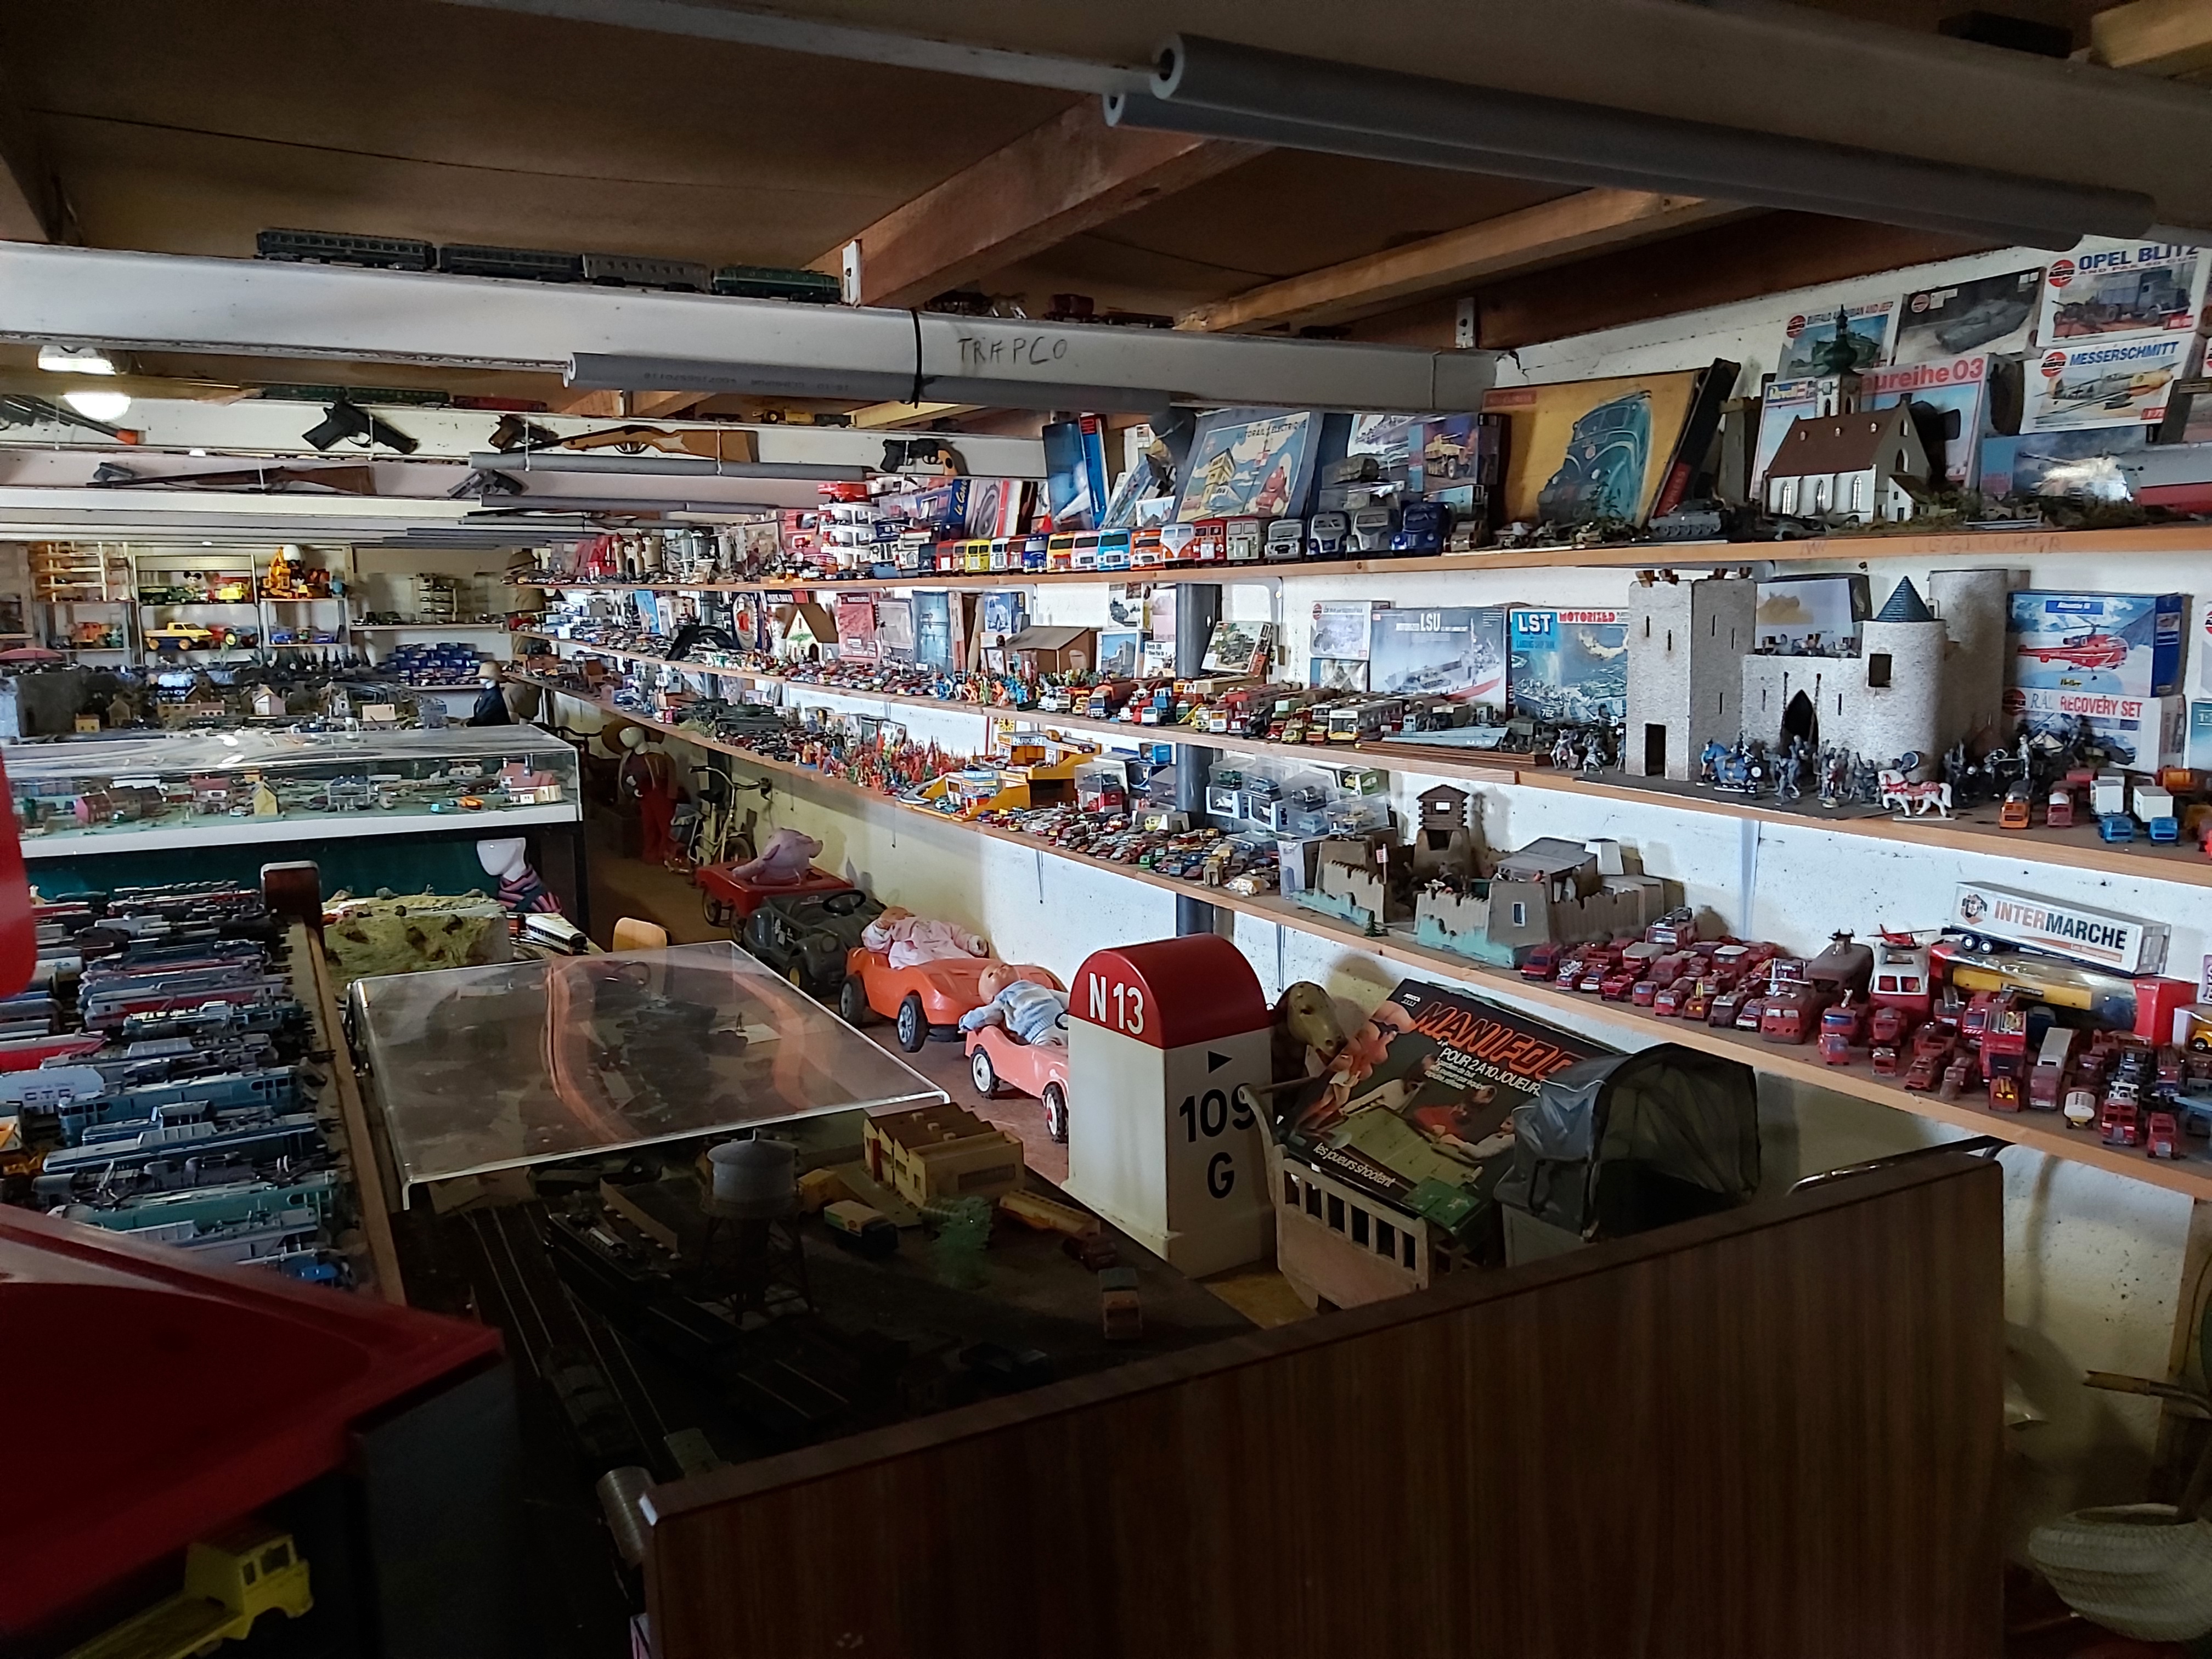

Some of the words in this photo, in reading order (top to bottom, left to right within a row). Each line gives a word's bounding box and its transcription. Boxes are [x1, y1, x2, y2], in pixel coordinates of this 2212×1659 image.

[2079, 251, 2131, 270] OPEL
[2070, 341, 2179, 366] MESSERSCHMITT
[1860, 364, 1949, 392] aureihe
[1953, 358, 1984, 380] 03
[1420, 613, 1441, 632] LSU
[1518, 614, 1552, 634] LST
[1559, 612, 1616, 623] MOTORIZED
[2061, 695, 2118, 715] RECOVERY
[2121, 700, 2143, 718] SET
[1013, 736, 1042, 746] PARKING
[1089, 972, 1107, 1023] N
[1113, 982, 1144, 1035] 13
[1439, 1047, 1472, 1068] POUR
[1468, 1059, 1480, 1071] 2
[1485, 1065, 1499, 1079] 10
[1207, 1152, 1235, 1199] G
[1313, 1142, 1329, 1155] les
[1322, 1149, 1358, 1170] joueurs
[1354, 1164, 1396, 1188] shootent
